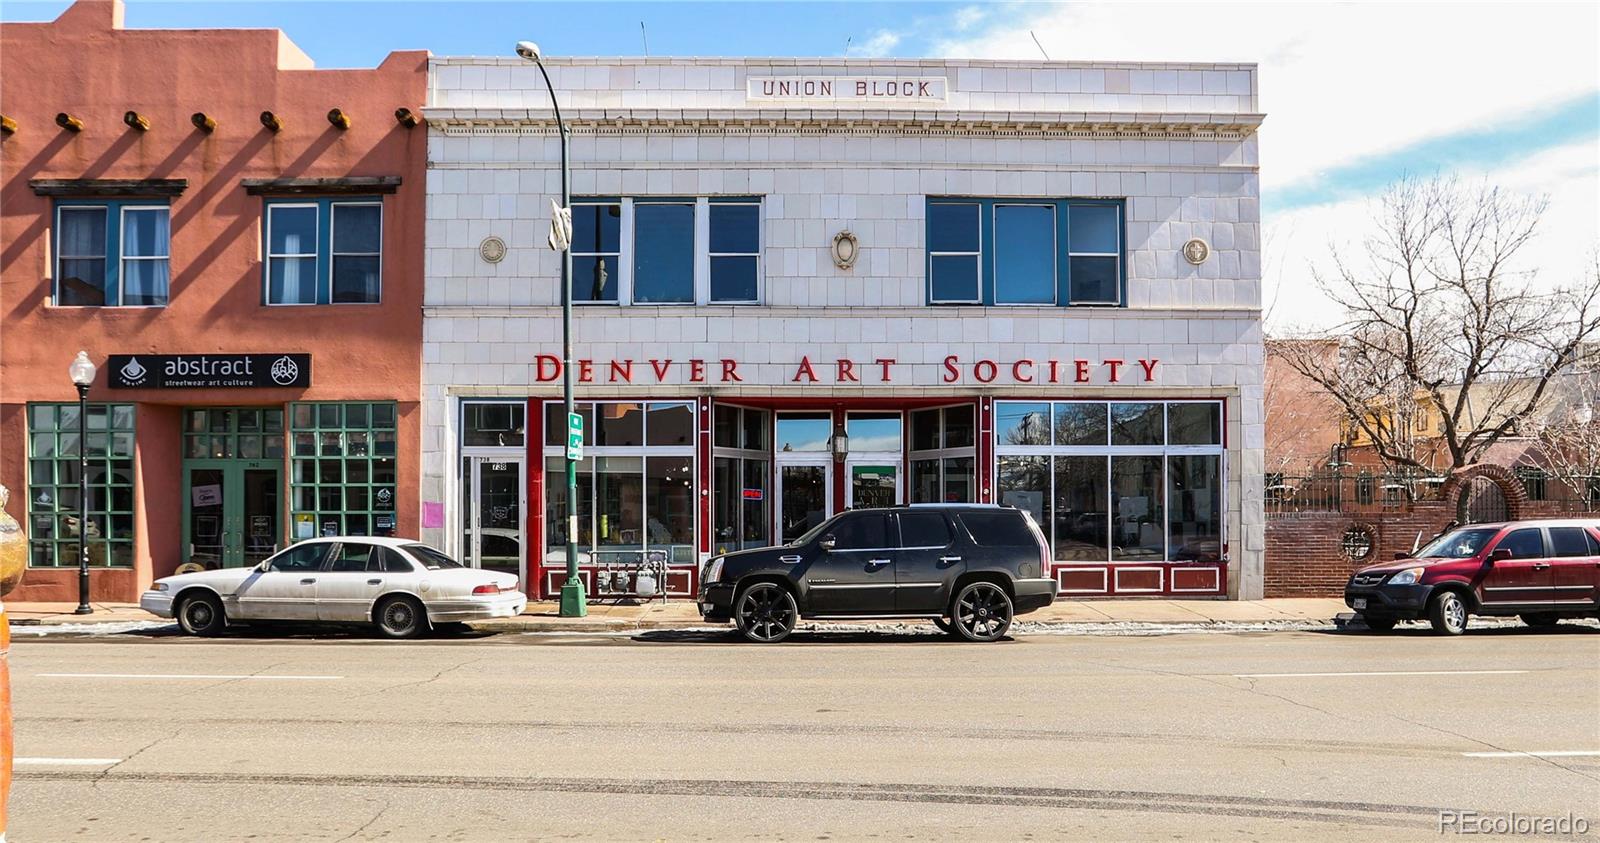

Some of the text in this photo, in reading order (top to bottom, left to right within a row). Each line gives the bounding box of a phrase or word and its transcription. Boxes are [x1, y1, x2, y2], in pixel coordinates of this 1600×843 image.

[763, 81, 934, 97] UNION BLOCK.
[165, 356, 253, 376] abstract
[534, 355, 1159, 383] DENVER ART SOCIETY
[492, 462, 507, 471] 738
